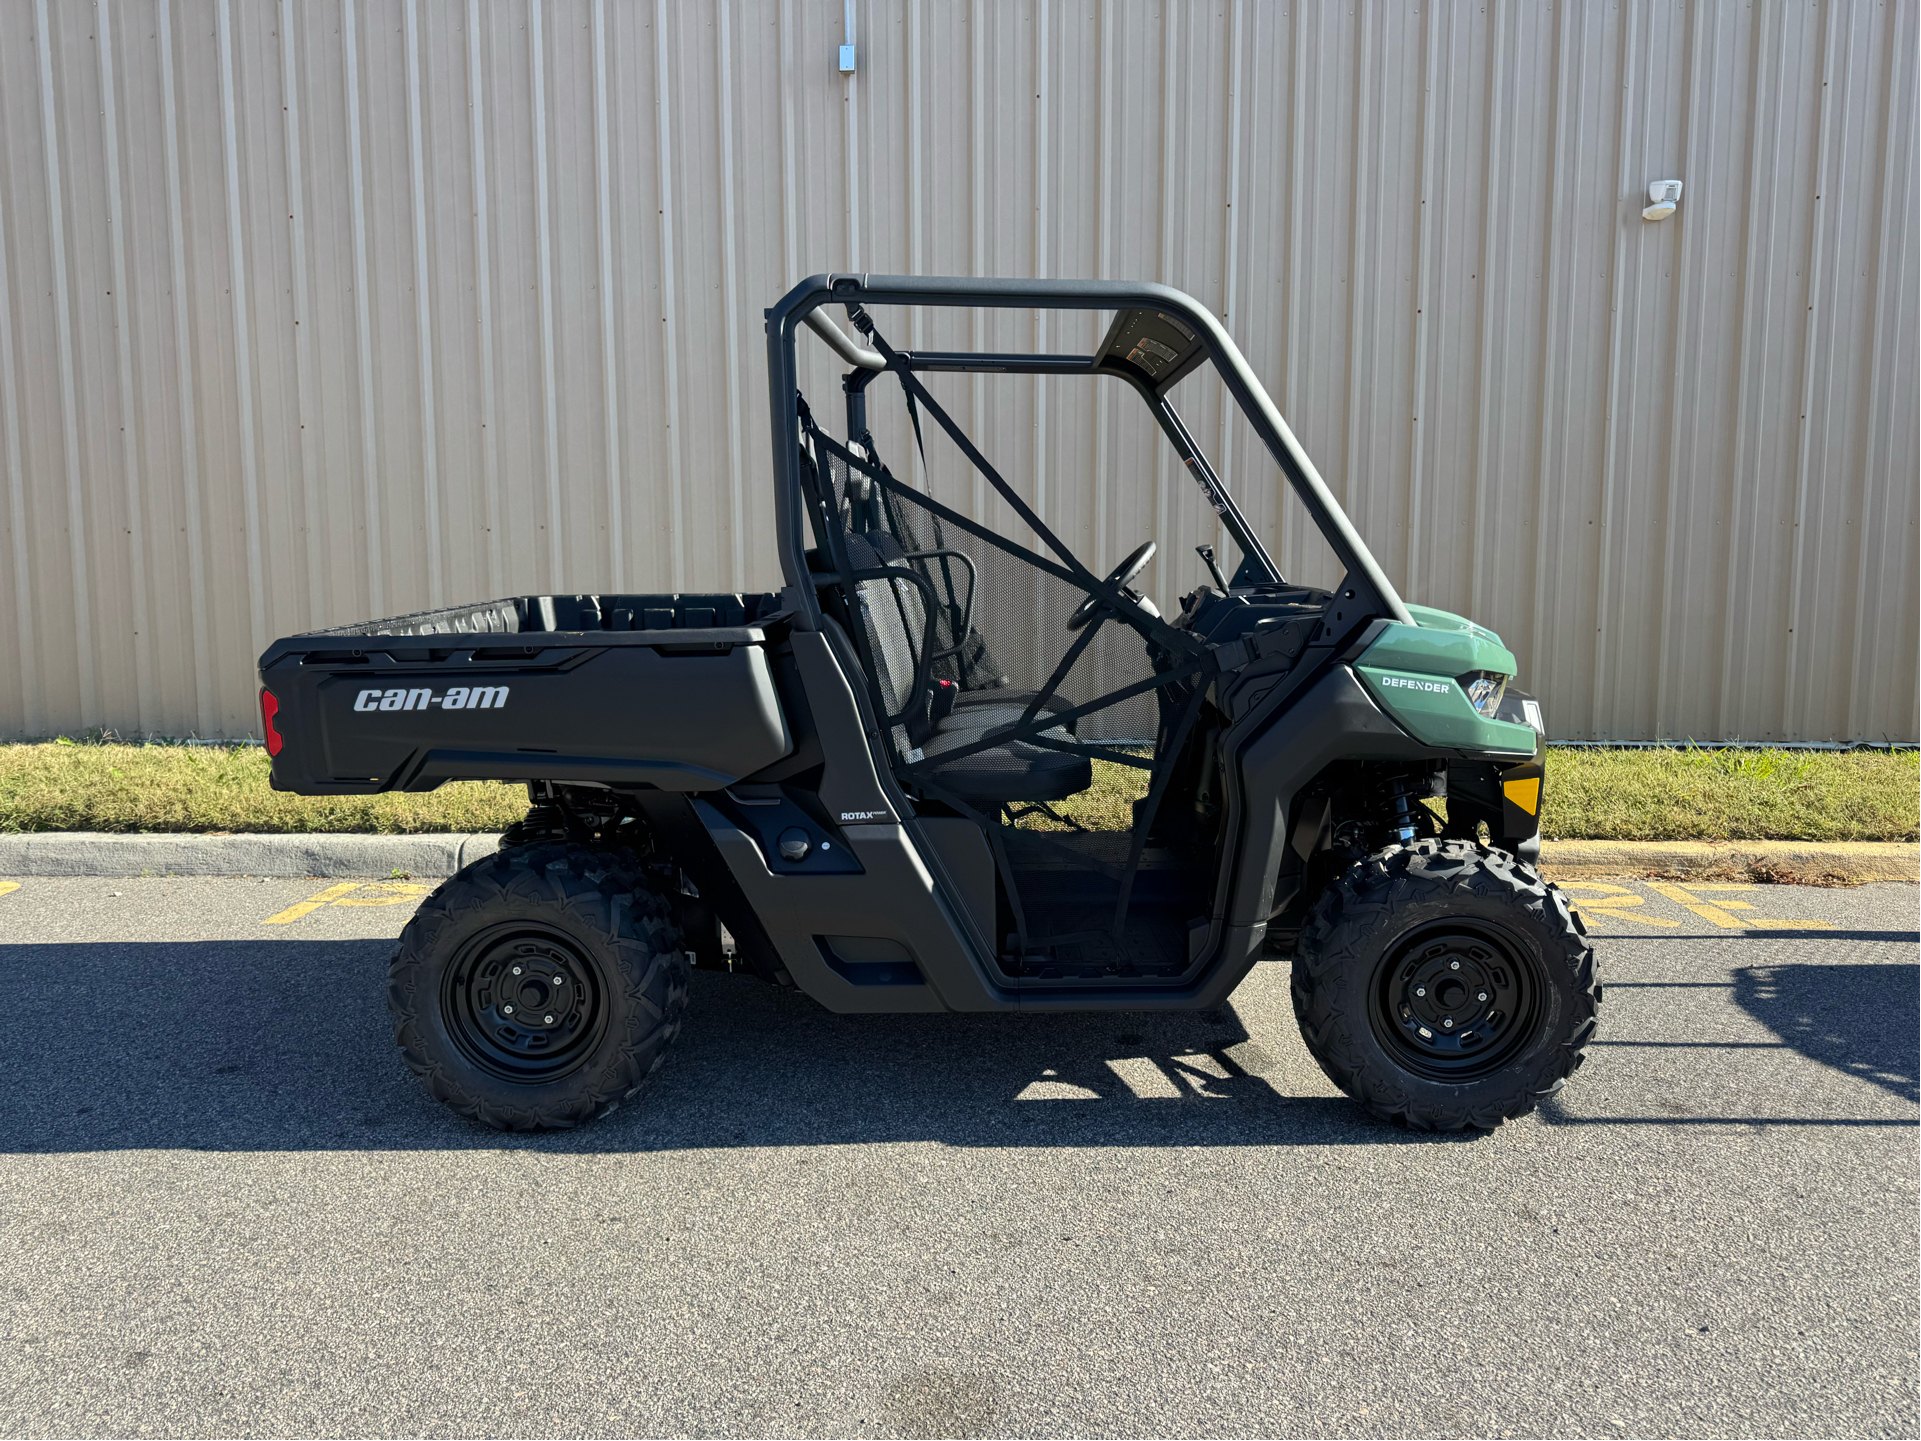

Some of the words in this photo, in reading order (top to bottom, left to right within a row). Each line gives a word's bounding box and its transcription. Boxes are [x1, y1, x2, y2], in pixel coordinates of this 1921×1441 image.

[1382, 676, 1450, 694] DEFENDER
[353, 685, 510, 712] can-am
[841, 811, 873, 820] ROTAX
